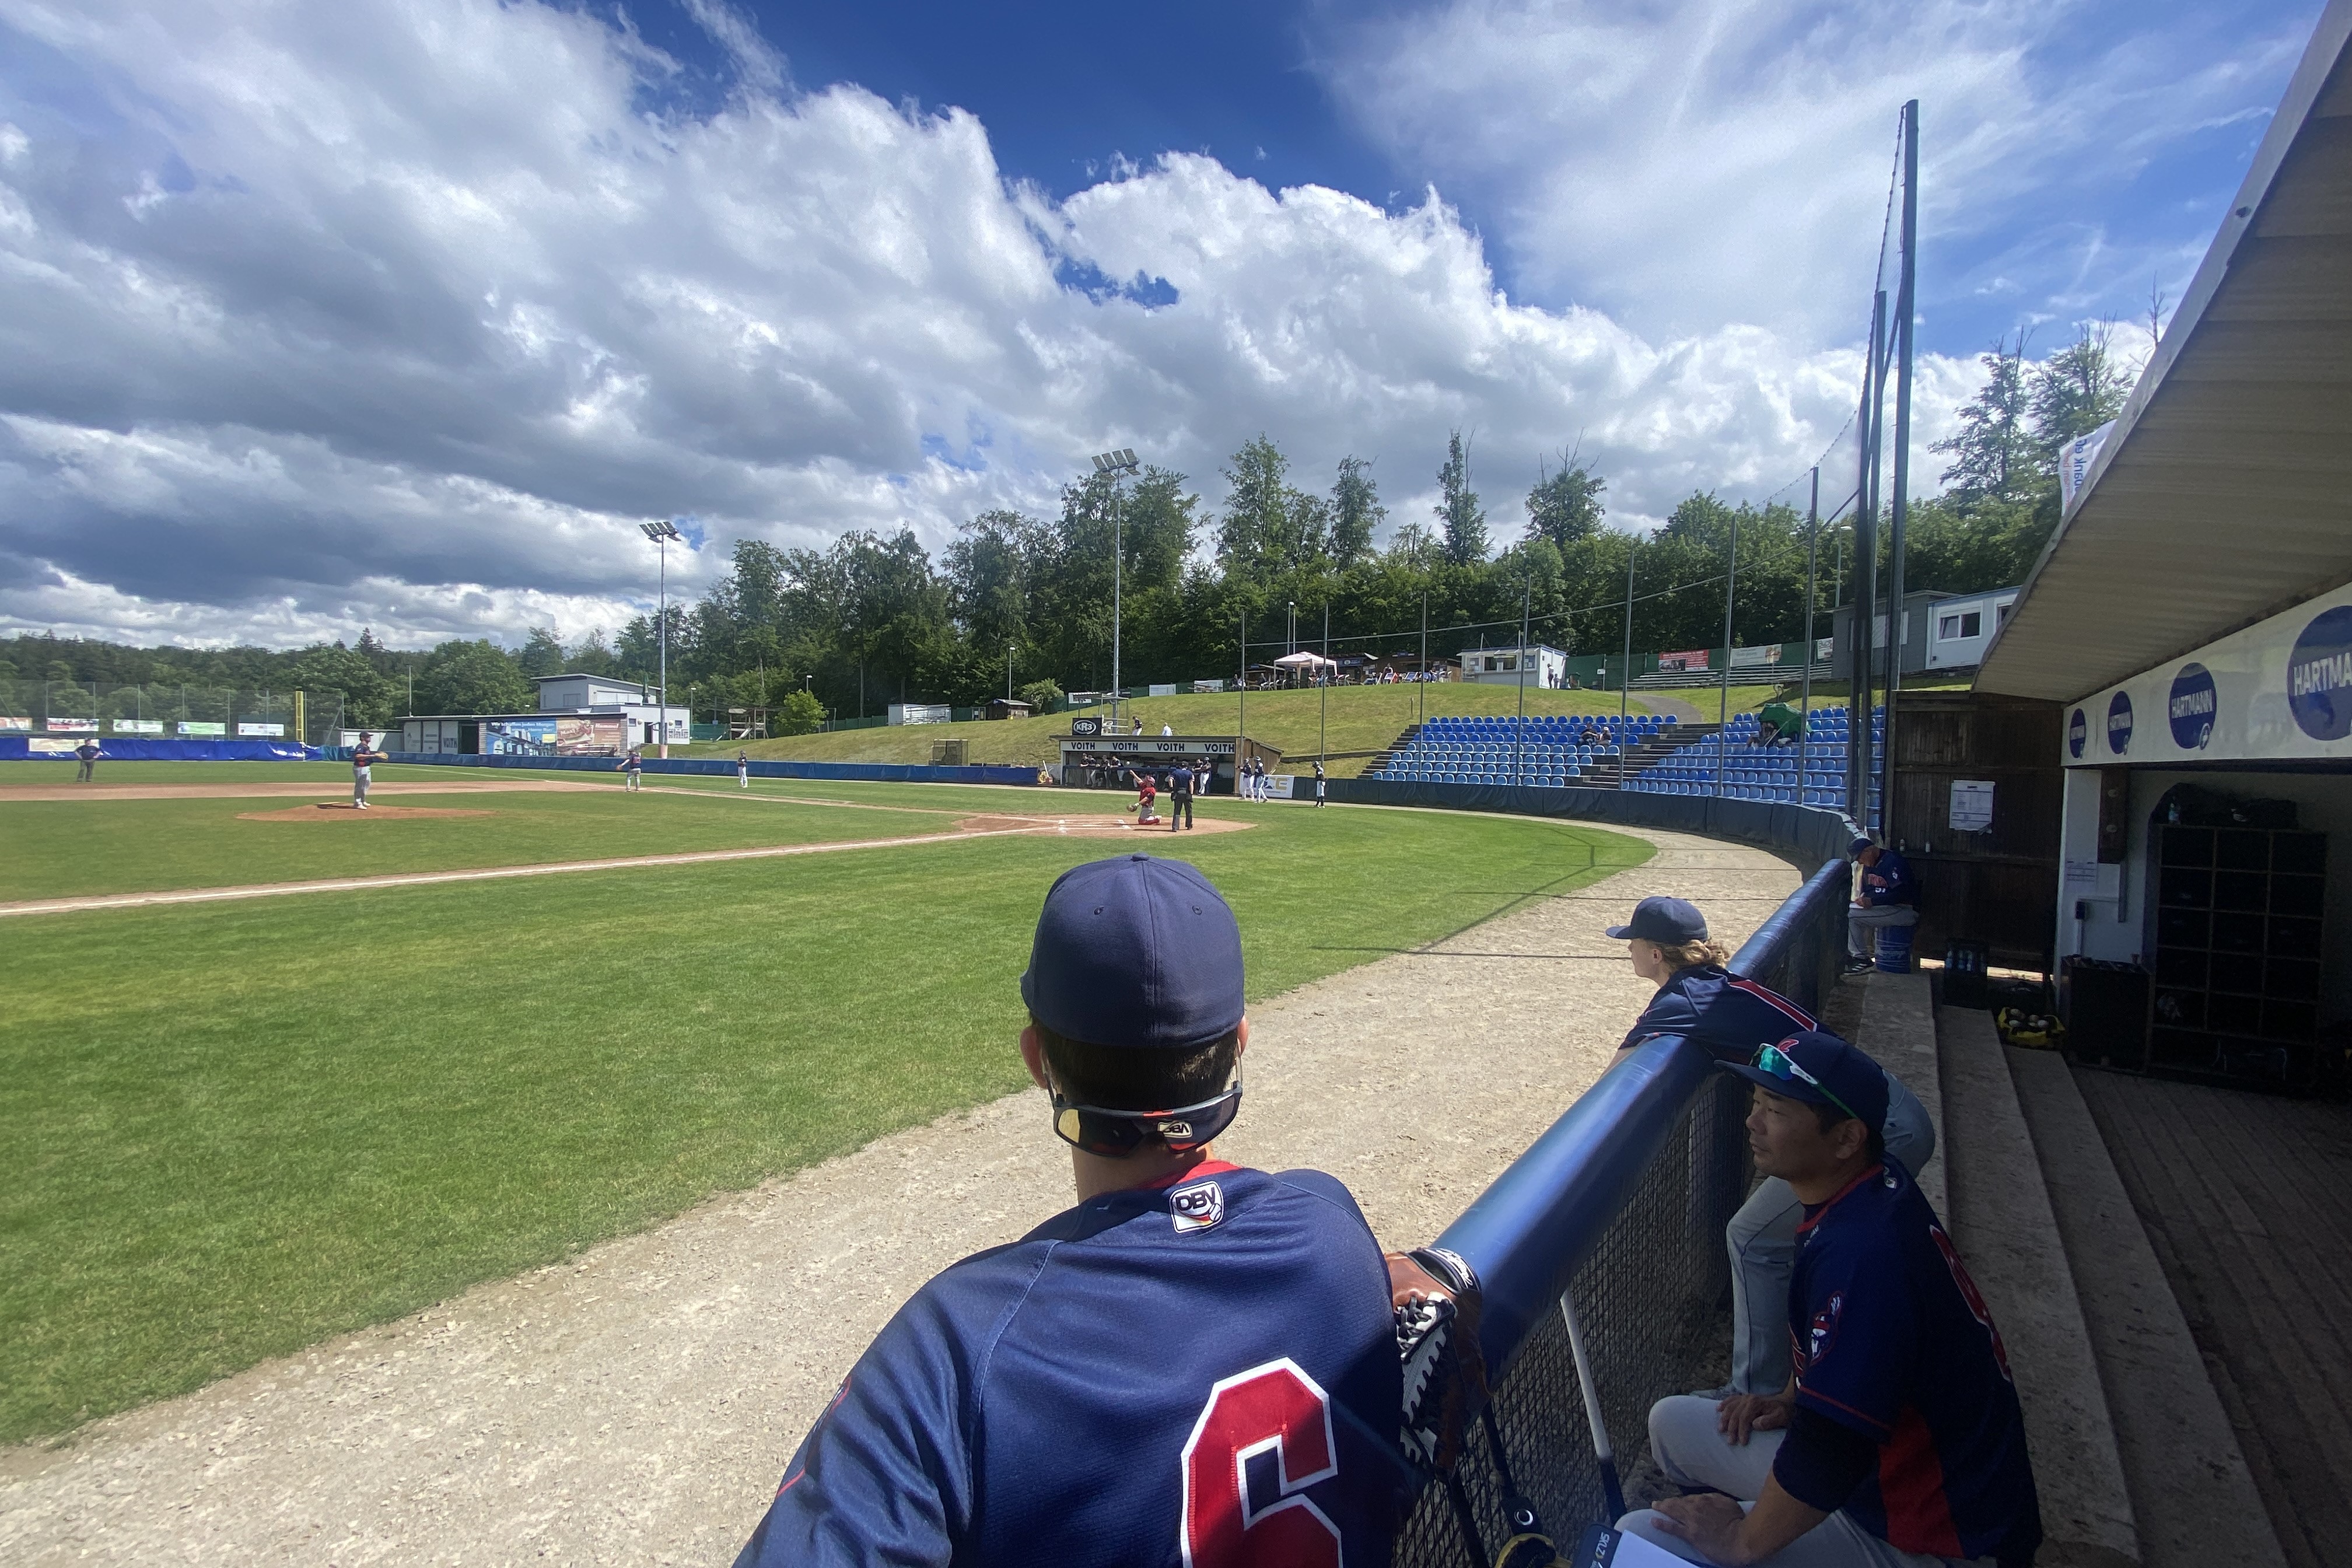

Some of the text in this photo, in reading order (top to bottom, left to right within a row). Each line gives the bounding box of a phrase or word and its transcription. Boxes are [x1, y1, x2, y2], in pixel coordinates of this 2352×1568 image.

[2171, 689, 2213, 719] HARTMANN
[1076, 722, 1093, 731] KR3
[1071, 742, 1235, 752] VOITH VOITH VOITH VOITH
[1175, 1186, 1215, 1211] DBV
